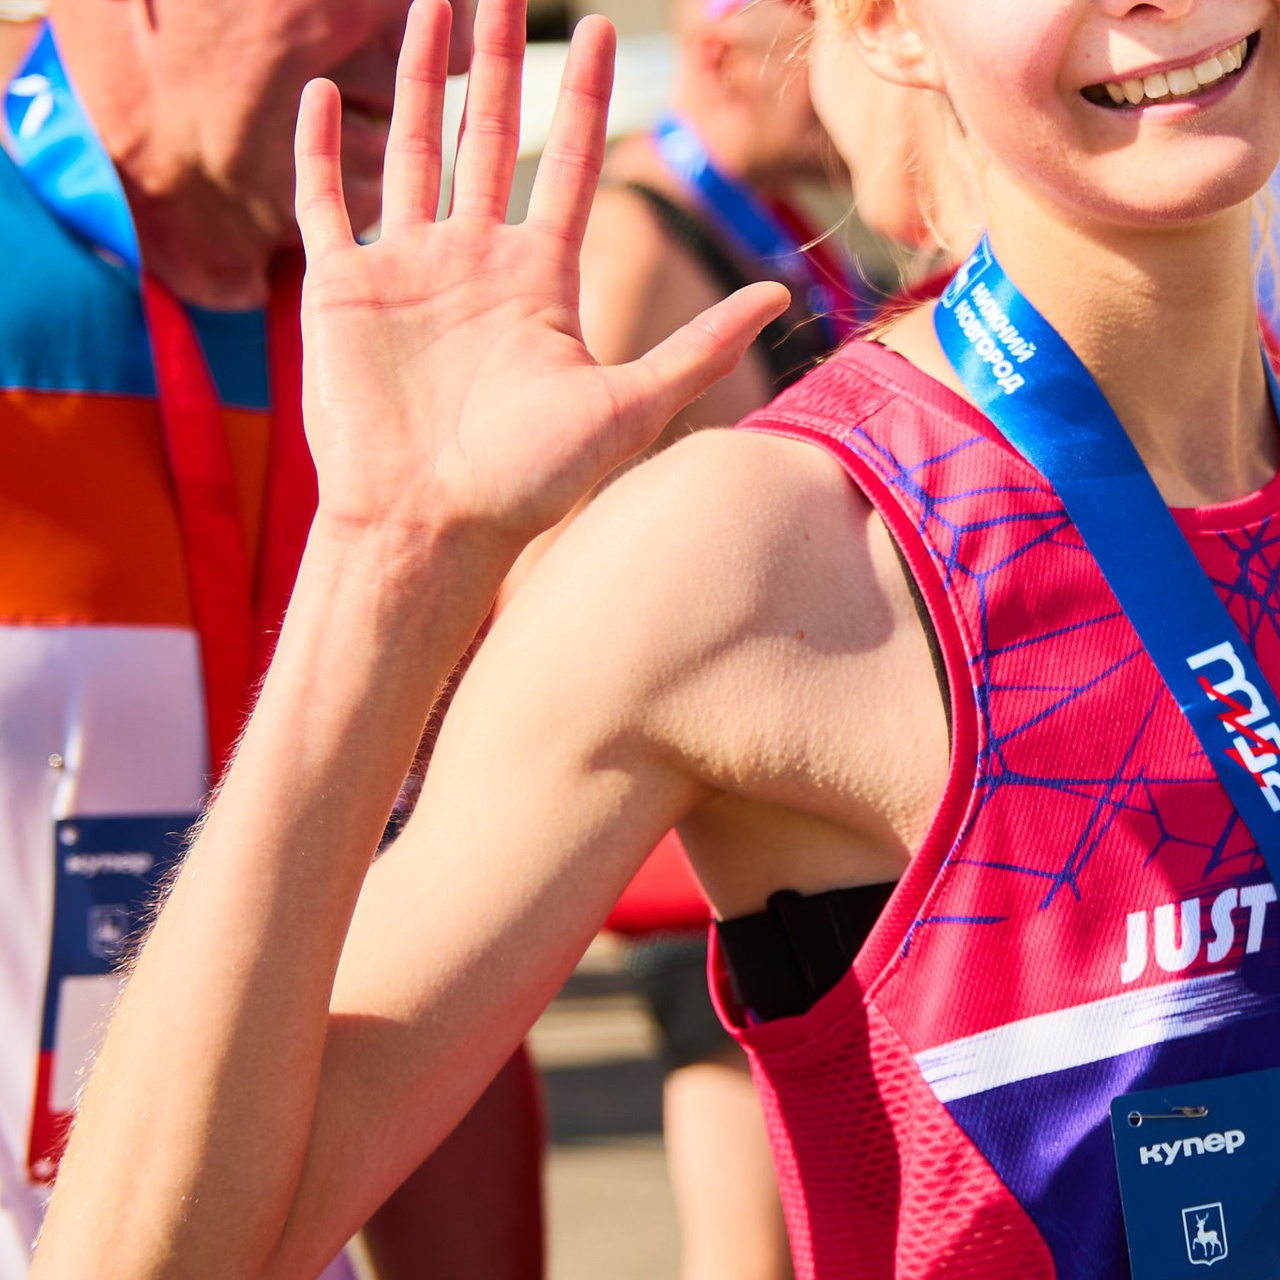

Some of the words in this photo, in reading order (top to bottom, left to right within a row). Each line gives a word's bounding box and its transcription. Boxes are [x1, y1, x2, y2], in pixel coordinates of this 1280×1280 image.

[953, 299, 1025, 395] НОВГОРОД
[970, 281, 1037, 363] НИЖНИЙ
[1121, 882, 1278, 985] JUST
[1139, 1129, 1246, 1166] купер
